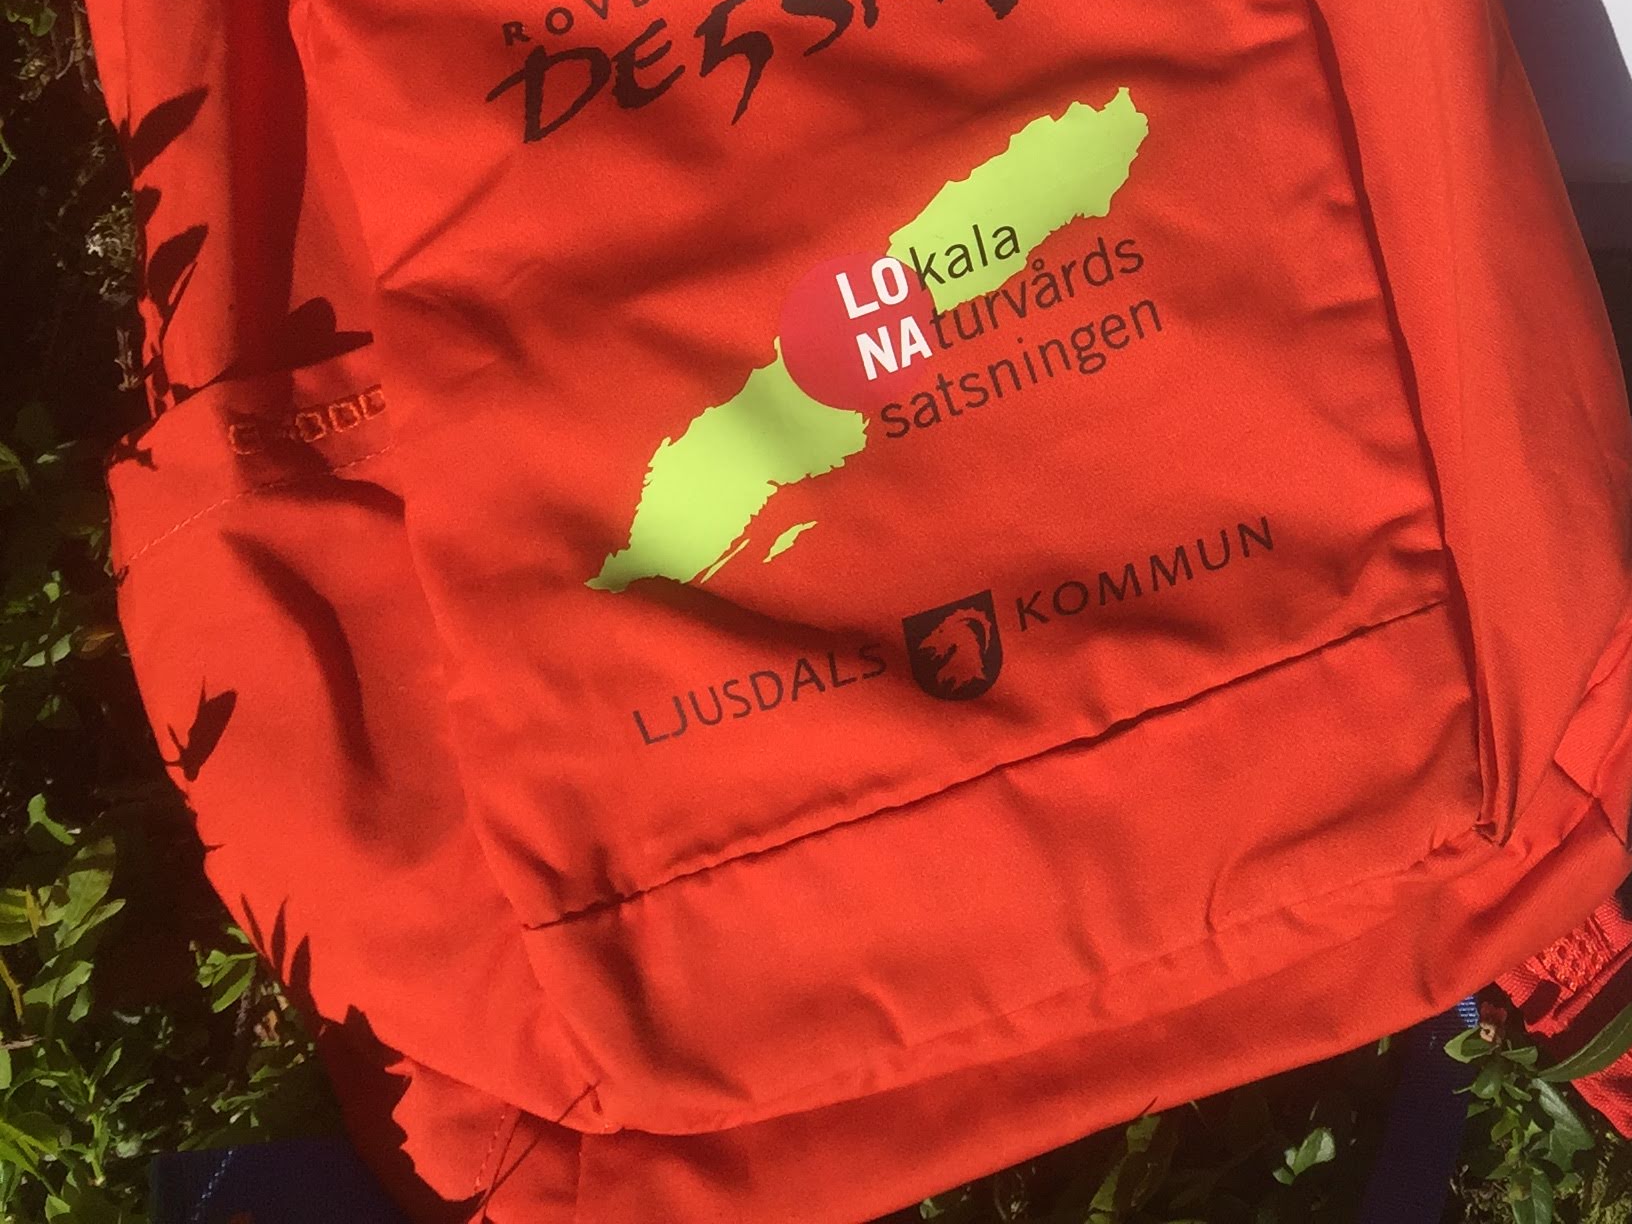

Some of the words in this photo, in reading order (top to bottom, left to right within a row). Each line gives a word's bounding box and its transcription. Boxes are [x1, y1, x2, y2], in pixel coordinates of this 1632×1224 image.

[485, 17, 686, 144] DE
[880, 298, 1163, 439] satsningen
[632, 642, 888, 746] LJUSDALS
[1014, 515, 1276, 632] KOMMUN
